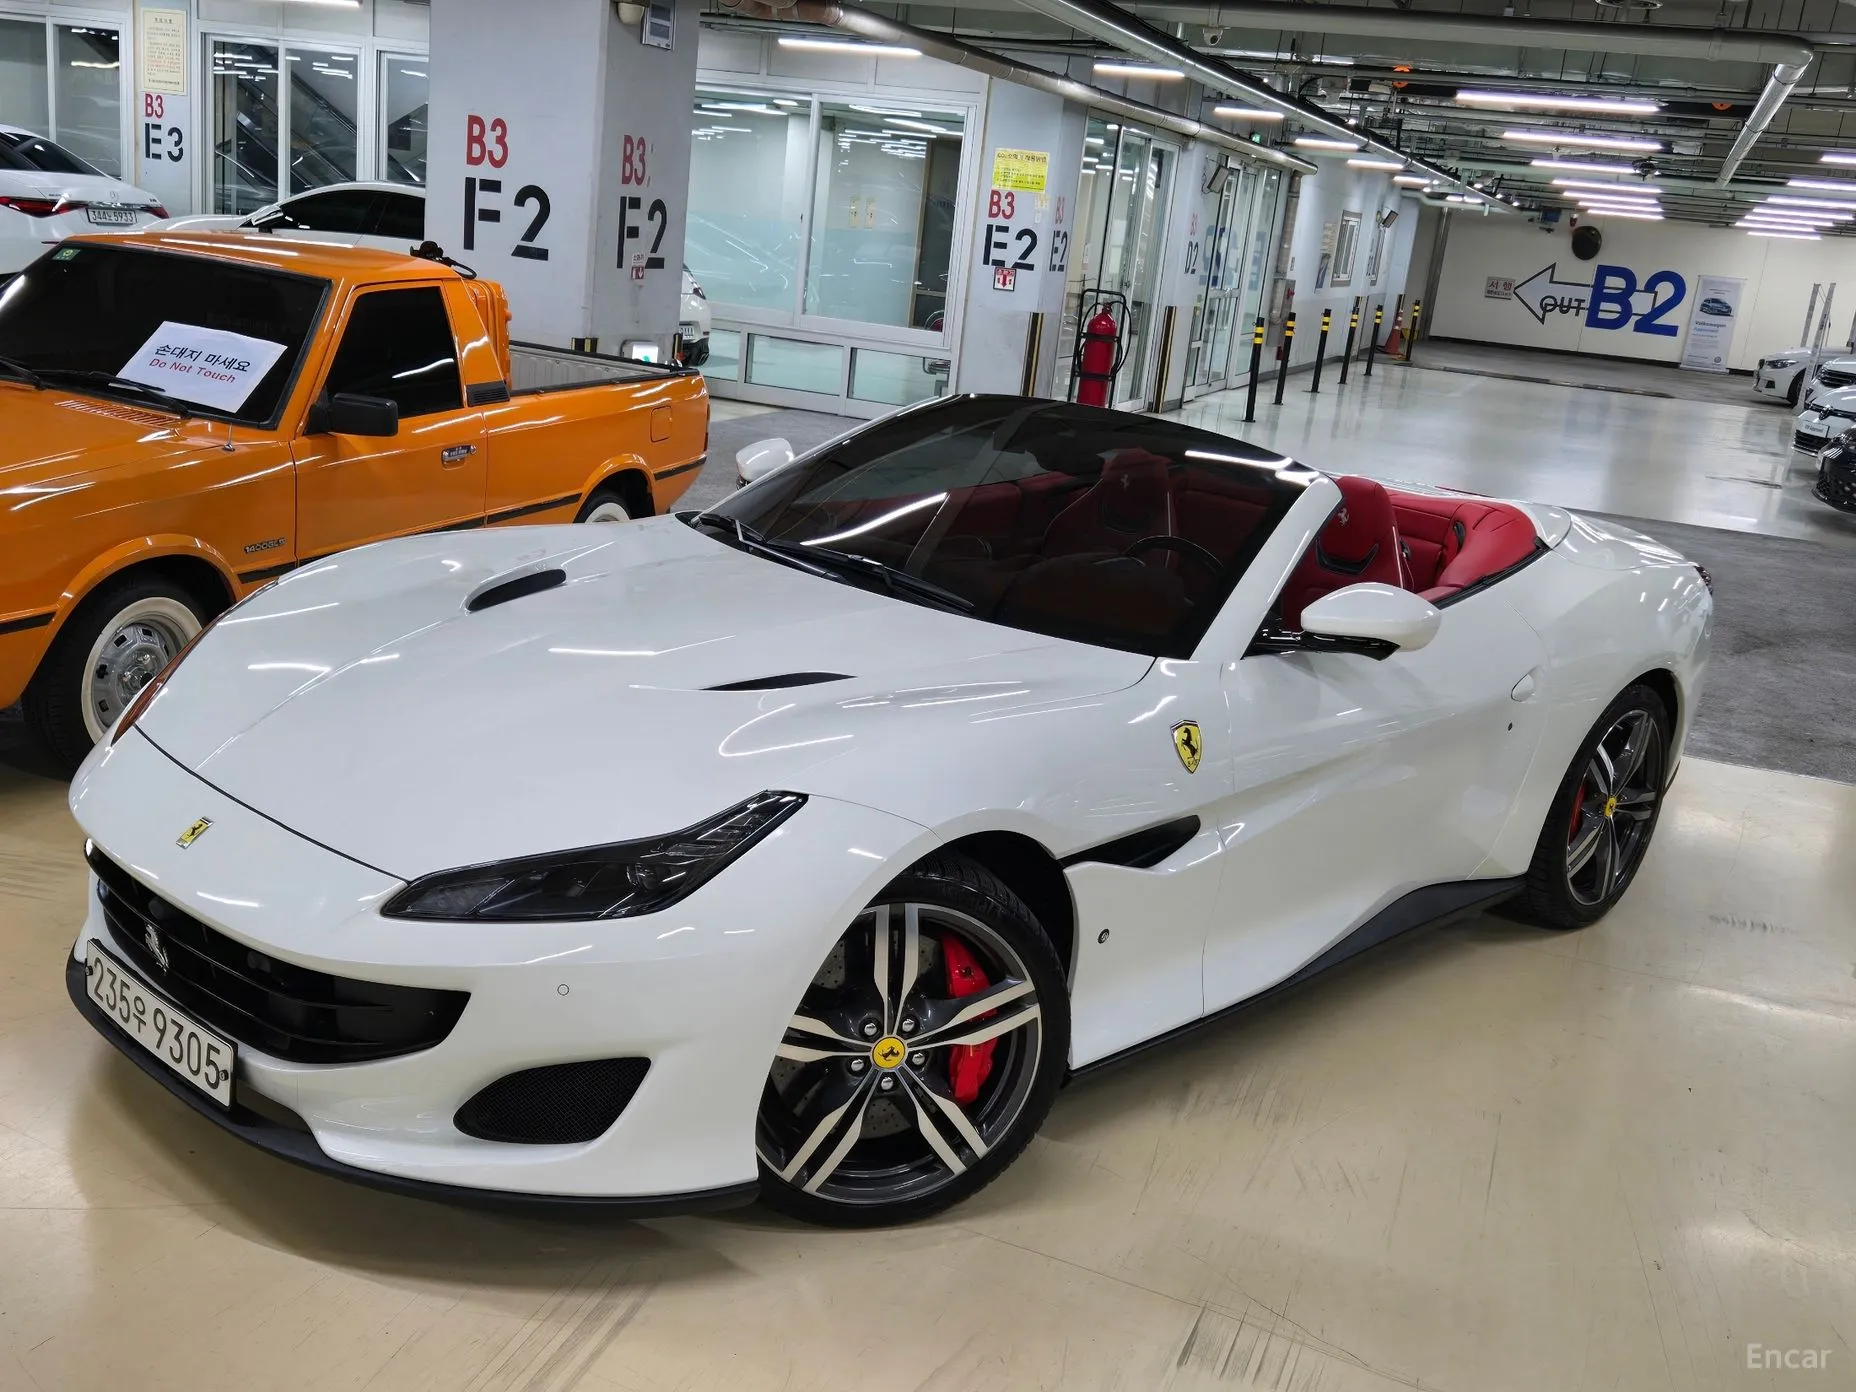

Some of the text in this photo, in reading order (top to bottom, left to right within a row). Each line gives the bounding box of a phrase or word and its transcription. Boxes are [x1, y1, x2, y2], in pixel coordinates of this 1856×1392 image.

[145, 93, 164, 119] B3
[144, 122, 184, 163] E3
[466, 114, 509, 169] B3
[621, 134, 646, 186] B3
[113, 211, 134, 222] 5933
[463, 176, 551, 262] F2
[987, 189, 1016, 220] B3
[616, 195, 668, 270] F2
[982, 223, 1038, 272] E2
[1049, 230, 1068, 272] E2
[1539, 295, 1586, 317] OUT
[1585, 264, 1687, 337] B2
[149, 358, 236, 384] Do Not Touch
[154, 344, 251, 373] 손대지 마세요
[93, 956, 221, 1090] 235우 9305
